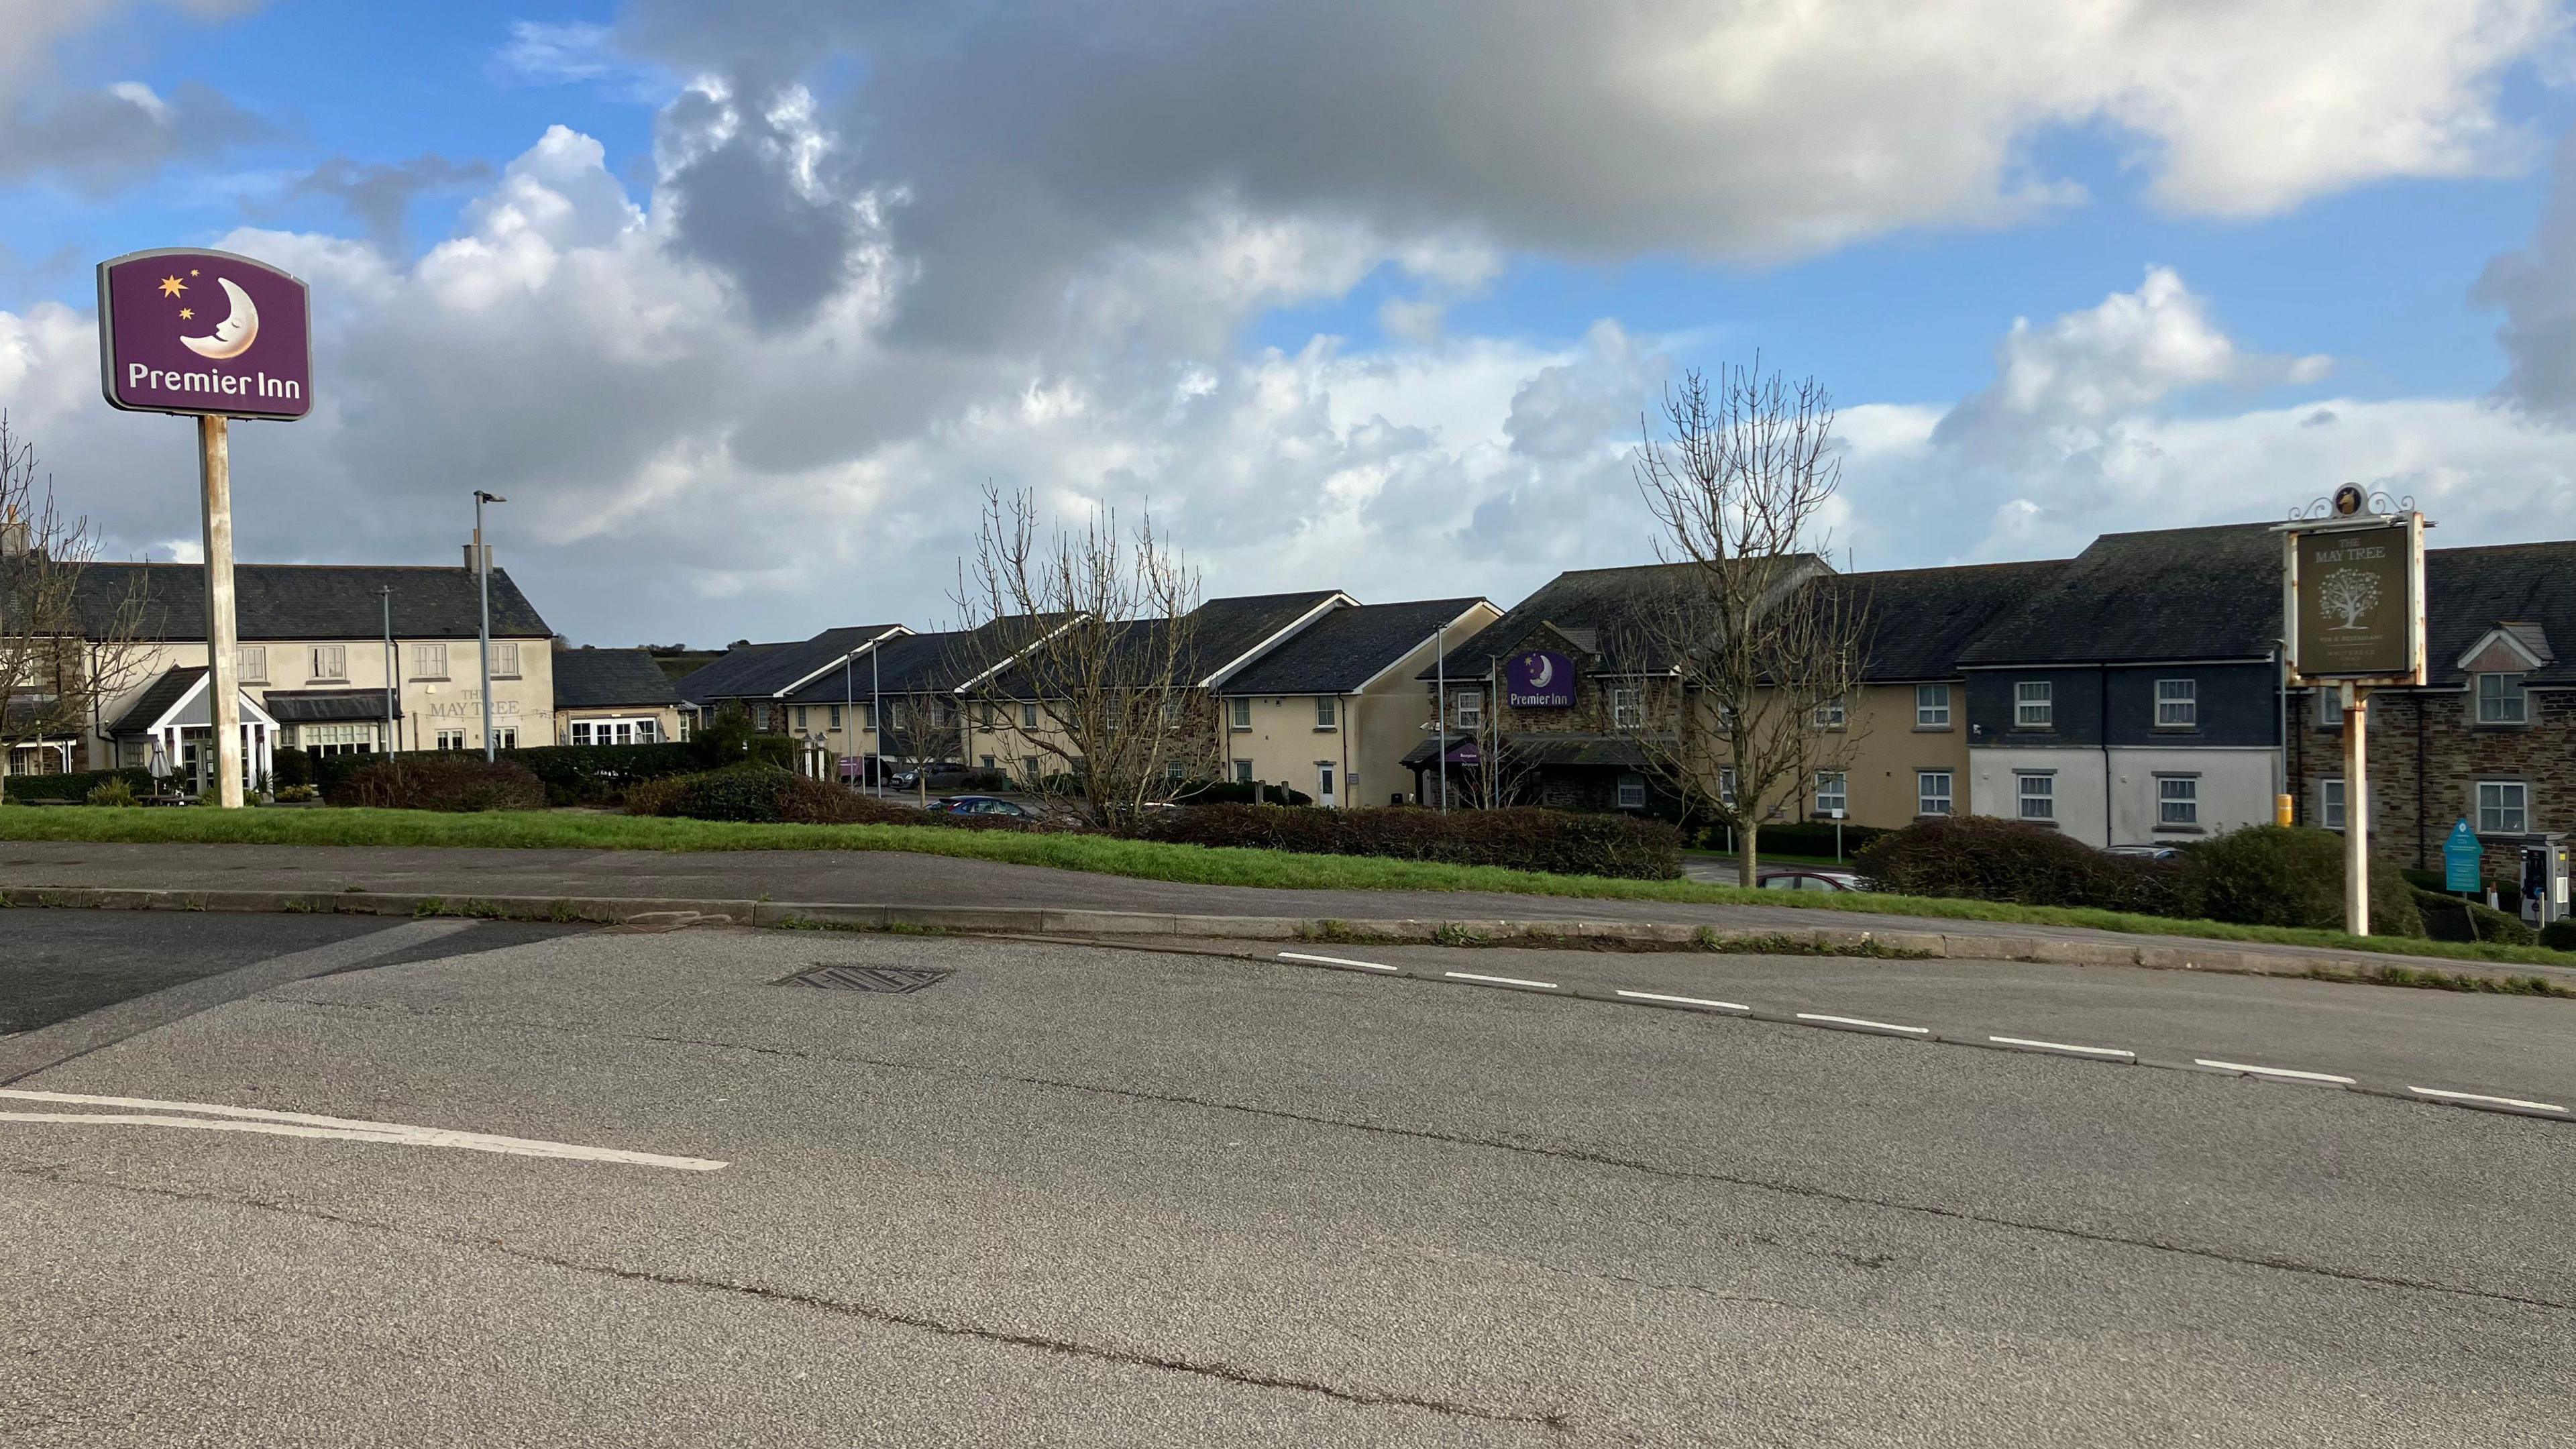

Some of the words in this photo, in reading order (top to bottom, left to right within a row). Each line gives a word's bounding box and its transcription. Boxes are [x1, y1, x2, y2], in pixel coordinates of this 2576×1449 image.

[128, 363, 252, 394] Premier
[258, 372, 300, 398] Inn
[2339, 537, 2361, 547] THE
[2316, 550, 2344, 563] MAY
[2347, 546, 2385, 560] TREE
[1511, 693, 1550, 705] Premier
[1552, 692, 1567, 705] Inn
[430, 702, 467, 716] MAY
